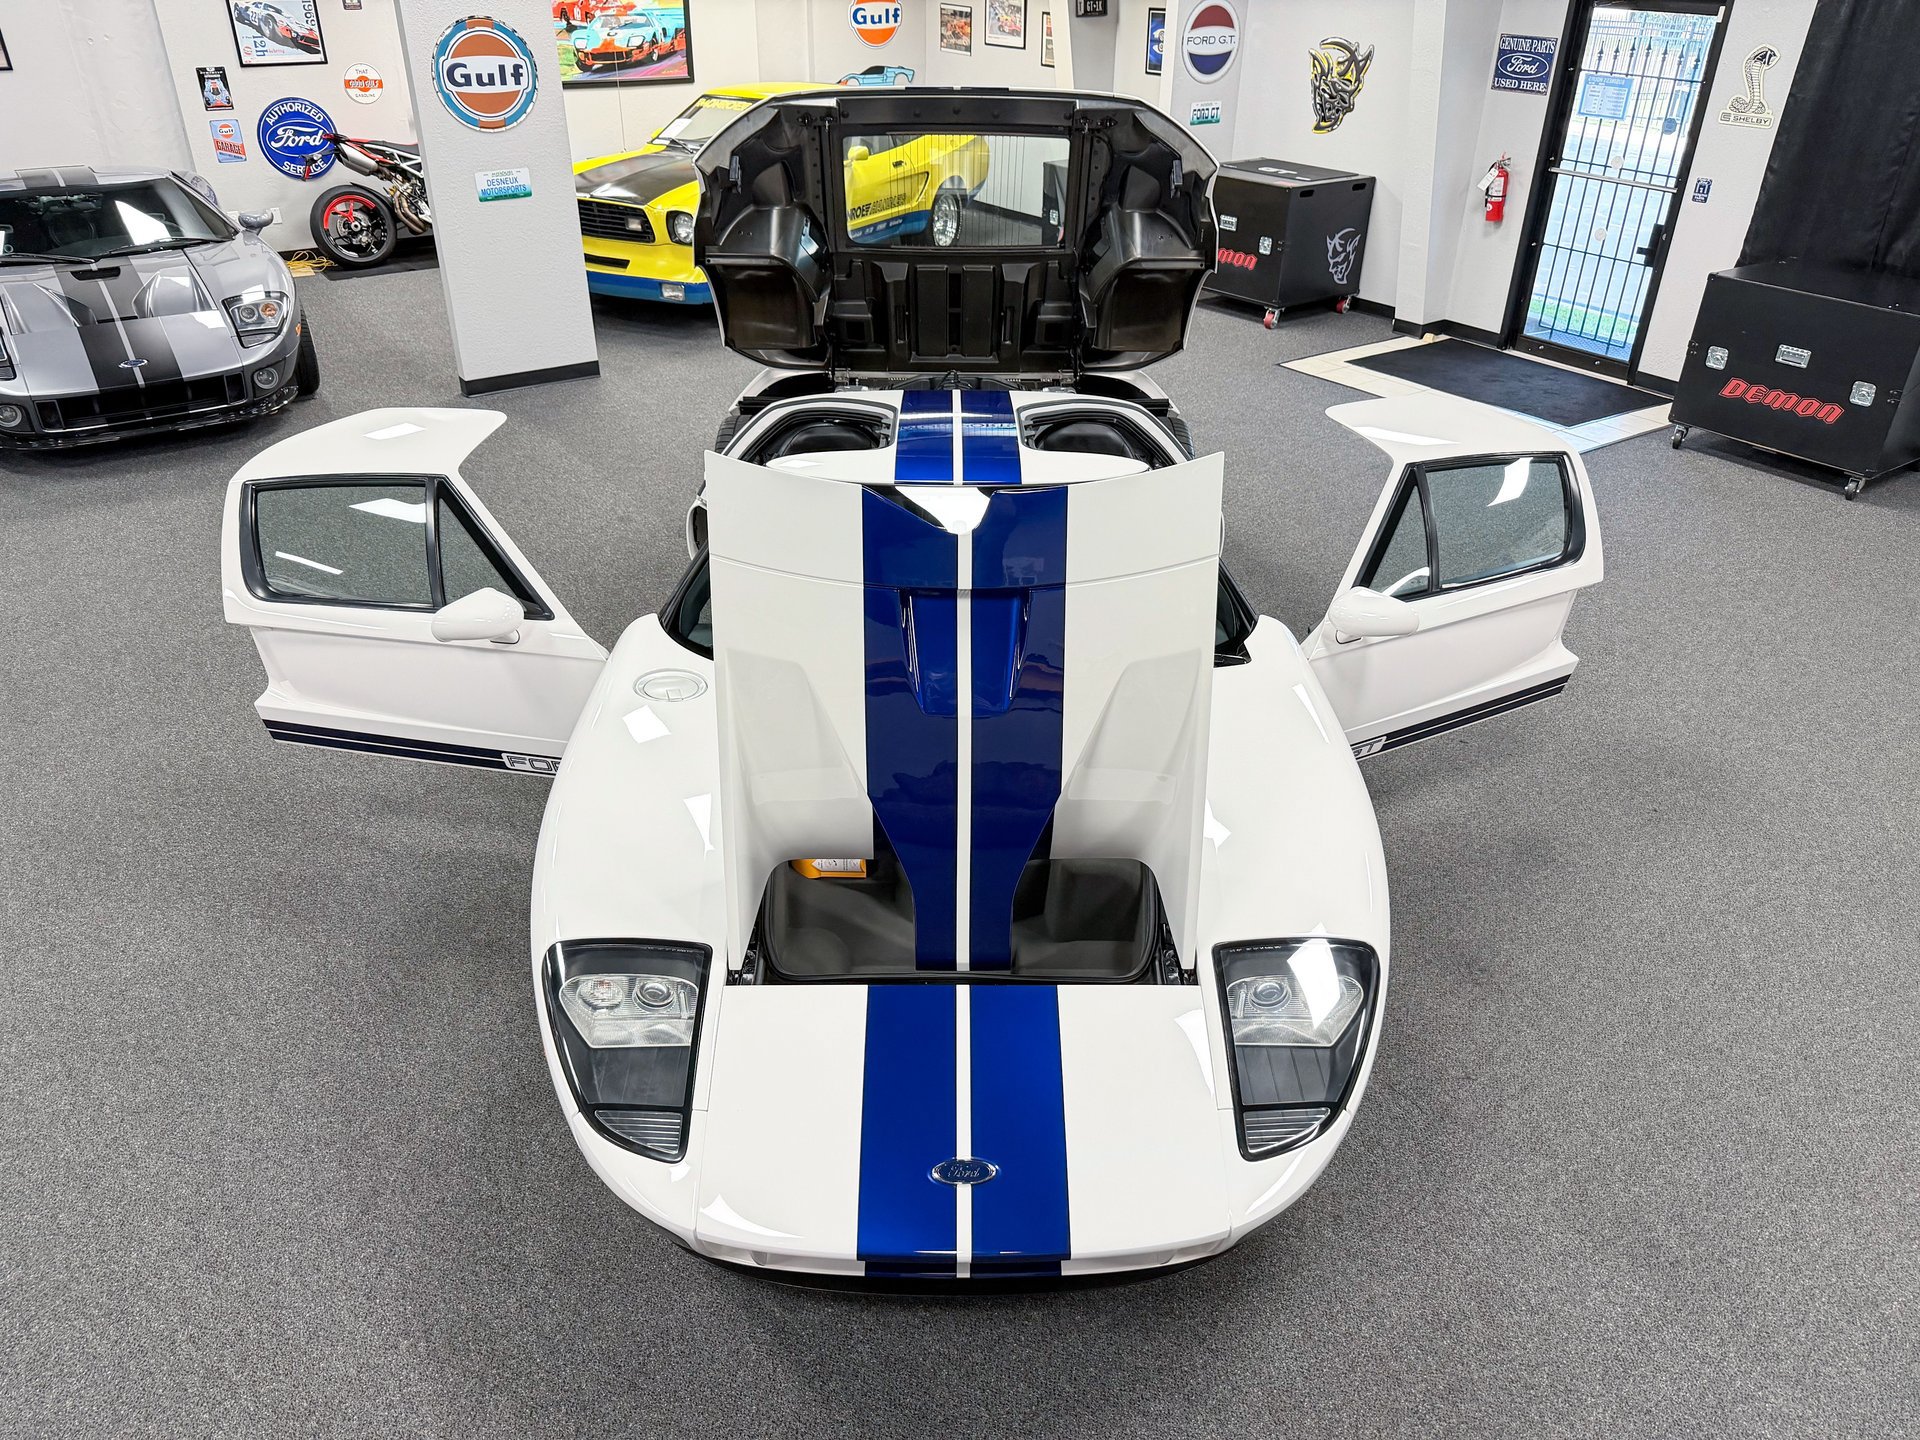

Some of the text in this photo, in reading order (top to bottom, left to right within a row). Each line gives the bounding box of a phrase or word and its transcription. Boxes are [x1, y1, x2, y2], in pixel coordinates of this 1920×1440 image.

[852, 7, 900, 25] Gulf
[1187, 34, 1236, 46] FORD G.T.
[1500, 36, 1556, 54] GENUINE PARTS
[1506, 55, 1540, 74] Ford
[446, 62, 524, 88] Gulf
[1494, 77, 1519, 88] USED
[265, 102, 324, 126] AUTHORIZED
[1192, 106, 1220, 121] FORD GT
[1732, 114, 1770, 125] SHELBY
[270, 126, 324, 148] Ford
[216, 140, 243, 155] GARAGE
[282, 158, 327, 174] SERICE
[486, 176, 519, 187] DESNEUX
[480, 183, 527, 197] MOTORSPORTS
[1718, 376, 1845, 425] DEMON
[946, 1162, 981, 1178] Ford
